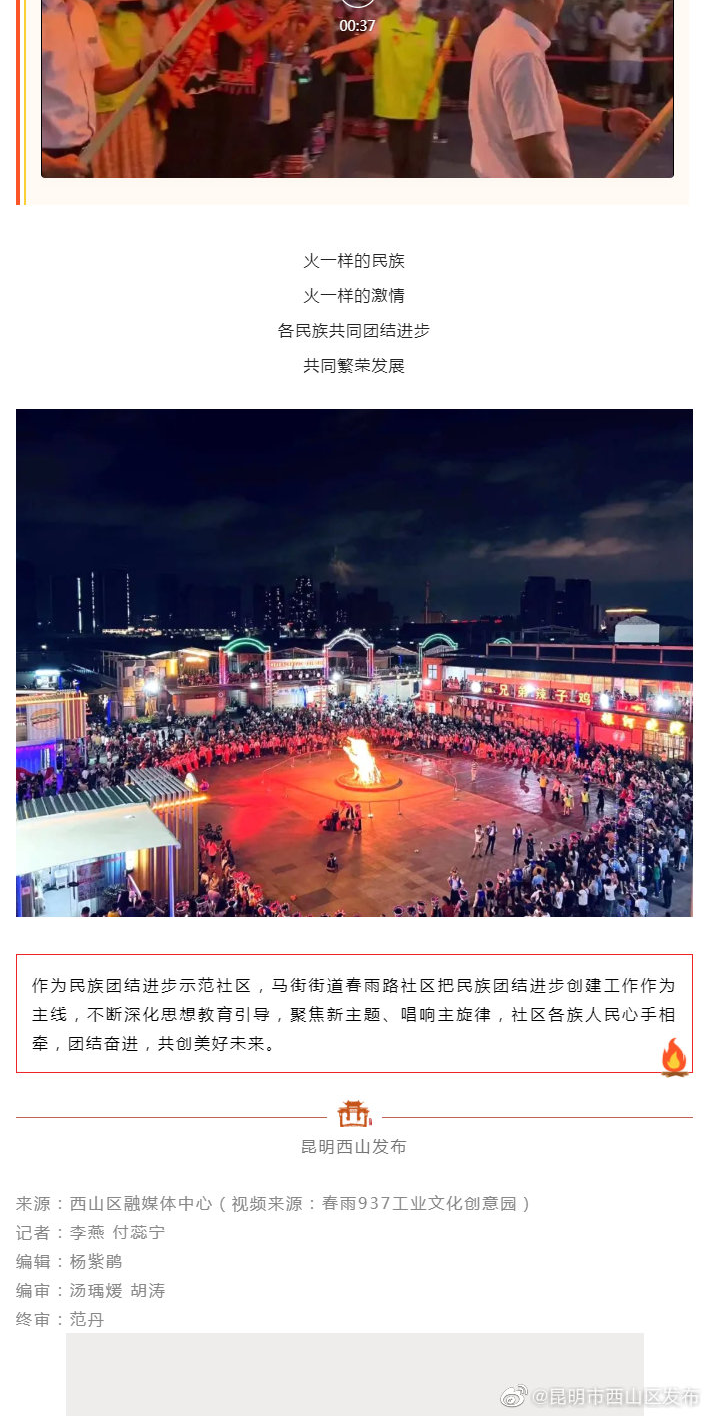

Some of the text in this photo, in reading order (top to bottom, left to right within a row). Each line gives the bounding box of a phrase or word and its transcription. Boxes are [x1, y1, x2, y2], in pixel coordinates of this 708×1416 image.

[303, 252, 405, 269] 火一样的民族
[303, 287, 405, 304] 火一样的激情
[277, 322, 431, 339] 各民族共同团结进步
[303, 357, 405, 374] 共同繁荣发展
[31, 976, 675, 994] 作为民族团结进步示范社区，马街街道春雨路社区把民族团结进步创建工作作为
[31, 1005, 675, 1023] 主线，不断深化思想教育引导，聚焦新主题、唱响主旋律，社区各族人民心手相
[31, 1034, 278, 1053] 牵，团结奋进，共创美好未来。
[301, 1138, 408, 1155] 昆明西山发布
[15, 1224, 166, 1241] 记者：李燕 付蕊宁
[15, 1252, 123, 1270] 编辑：杨紫鹃
[130, 1282, 166, 1299] 胡涛
[15, 1310, 105, 1328] 终审：范丹
